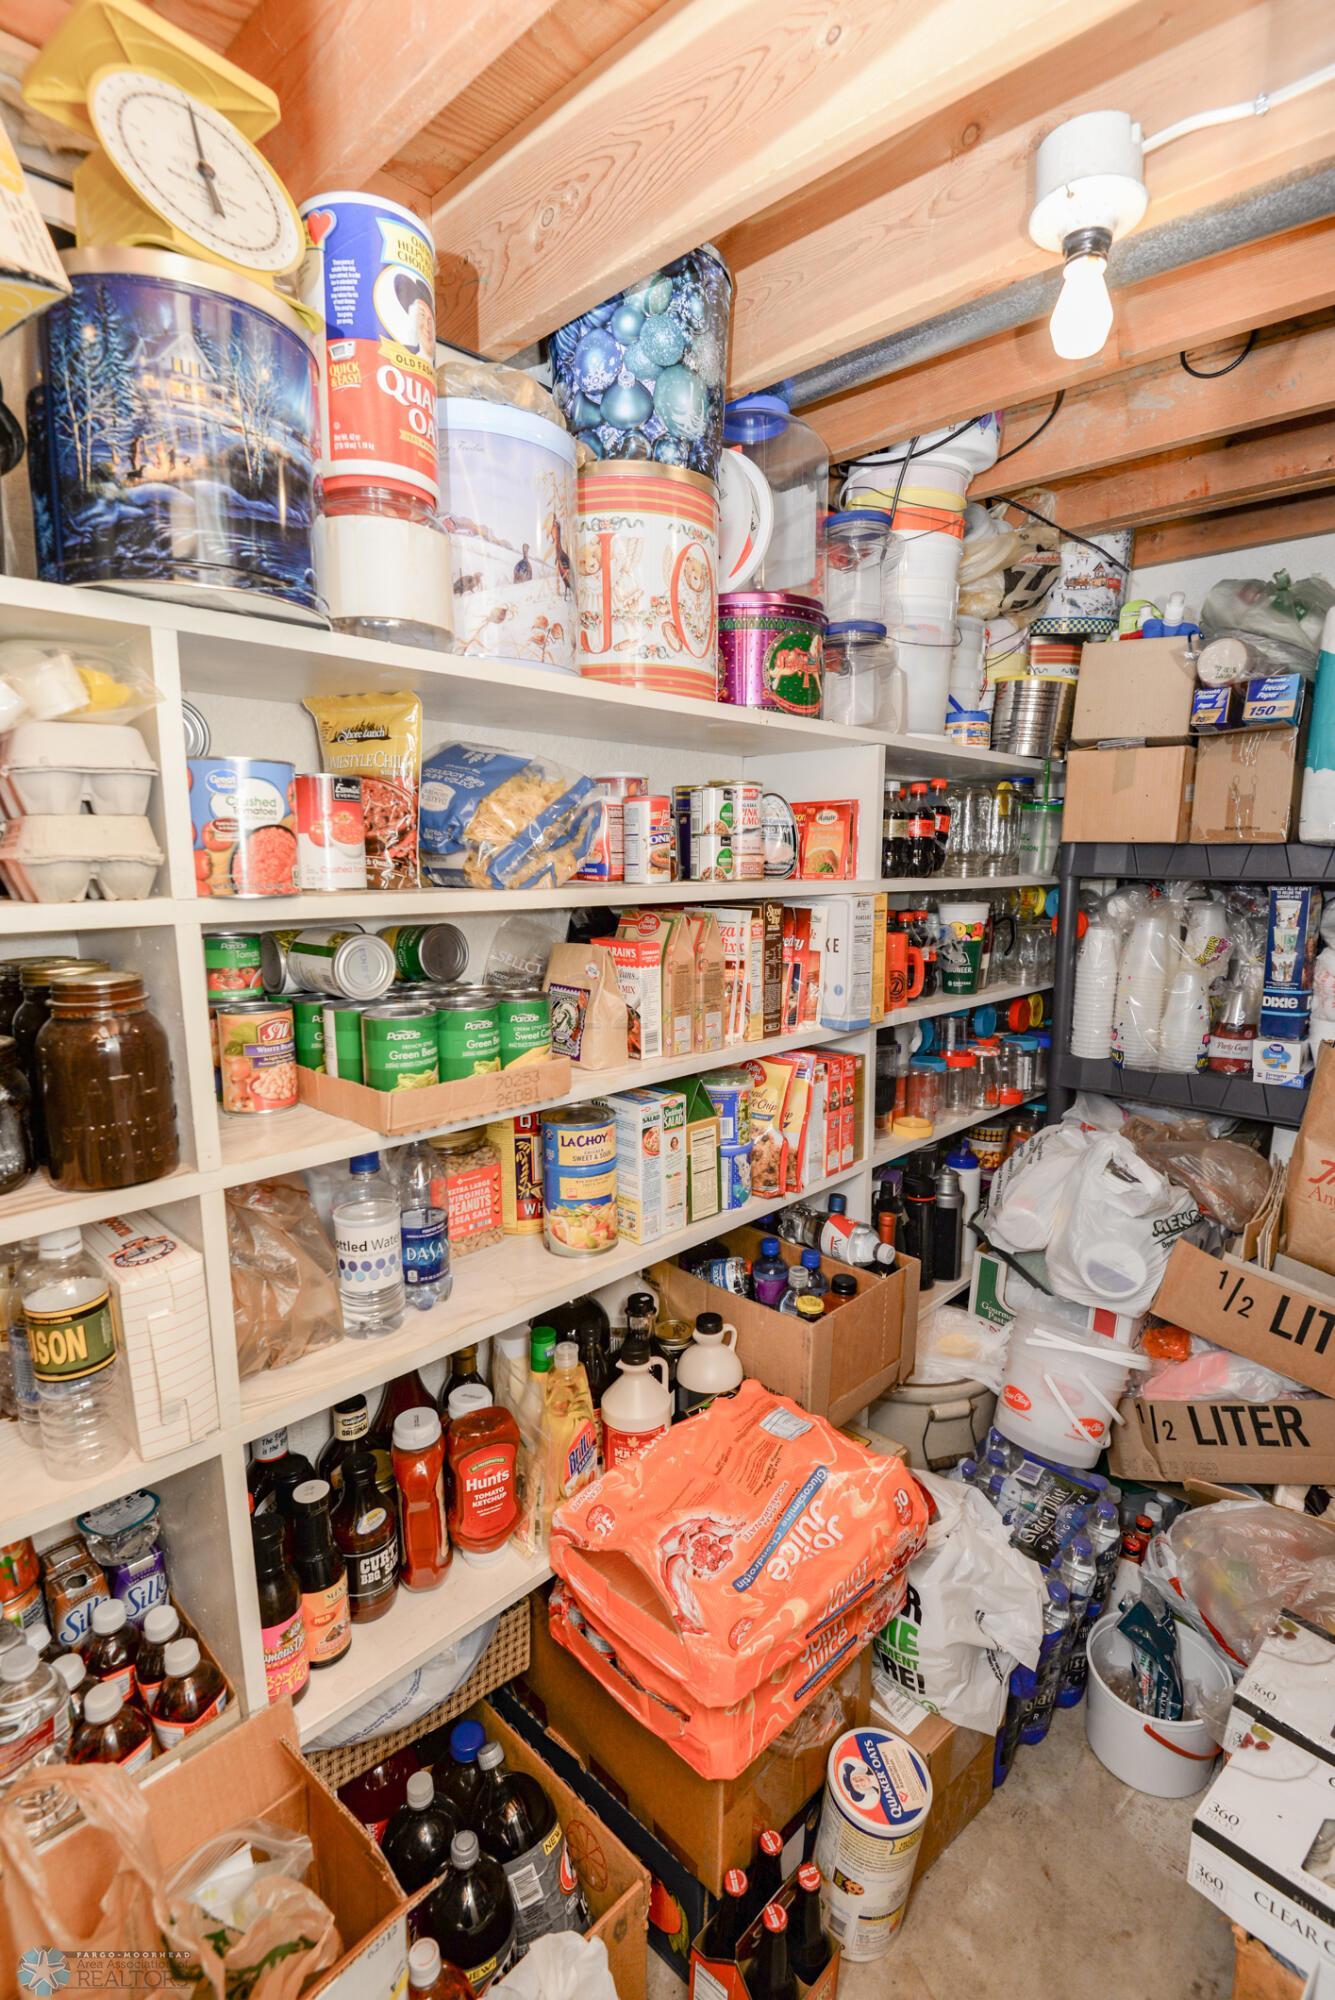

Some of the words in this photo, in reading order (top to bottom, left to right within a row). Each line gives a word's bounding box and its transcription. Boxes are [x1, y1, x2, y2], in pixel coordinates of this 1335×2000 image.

[329, 361, 359, 376] QUICK
[396, 353, 415, 367] OLD
[1248, 705, 1277, 717] 150
[220, 941, 248, 950] Parade
[1262, 996, 1298, 1009] DIXIE
[464, 1020, 494, 1031] Parade
[510, 1013, 540, 1023] Parade
[386, 1031, 421, 1041] Parade
[466, 1038, 492, 1049] Green
[514, 1032, 540, 1041] Sweet
[388, 1051, 420, 1061] Green
[571, 1155, 593, 1163] SWEET
[448, 1187, 491, 1205] VIRGINIA
[448, 1193, 493, 1218] PEANUTS
[454, 1212, 471, 1226] SEA
[471, 1206, 491, 1219] SALT
[1186, 1405, 1311, 1448] LITER
[471, 1491, 508, 1508] KETCHUP
[473, 1485, 505, 1501] TOMATO
[778, 1467, 827, 1528] Glucosamine
[766, 1499, 824, 1583] Juice
[735, 1530, 783, 1590] Chondroitin
[360, 1570, 382, 1586] BBQ
[127, 1574, 169, 1618] Silk
[803, 1627, 849, 1681] Juice
[1250, 1680, 1278, 1702] 360
[863, 1739, 881, 1769] OATS
[875, 1773, 903, 1819] QUAKER
[1207, 1802, 1241, 1828] 360
[544, 1833, 564, 1853] NEW
[1195, 1863, 1225, 1892] 360
[1253, 1890, 1318, 1945] CLEAR
